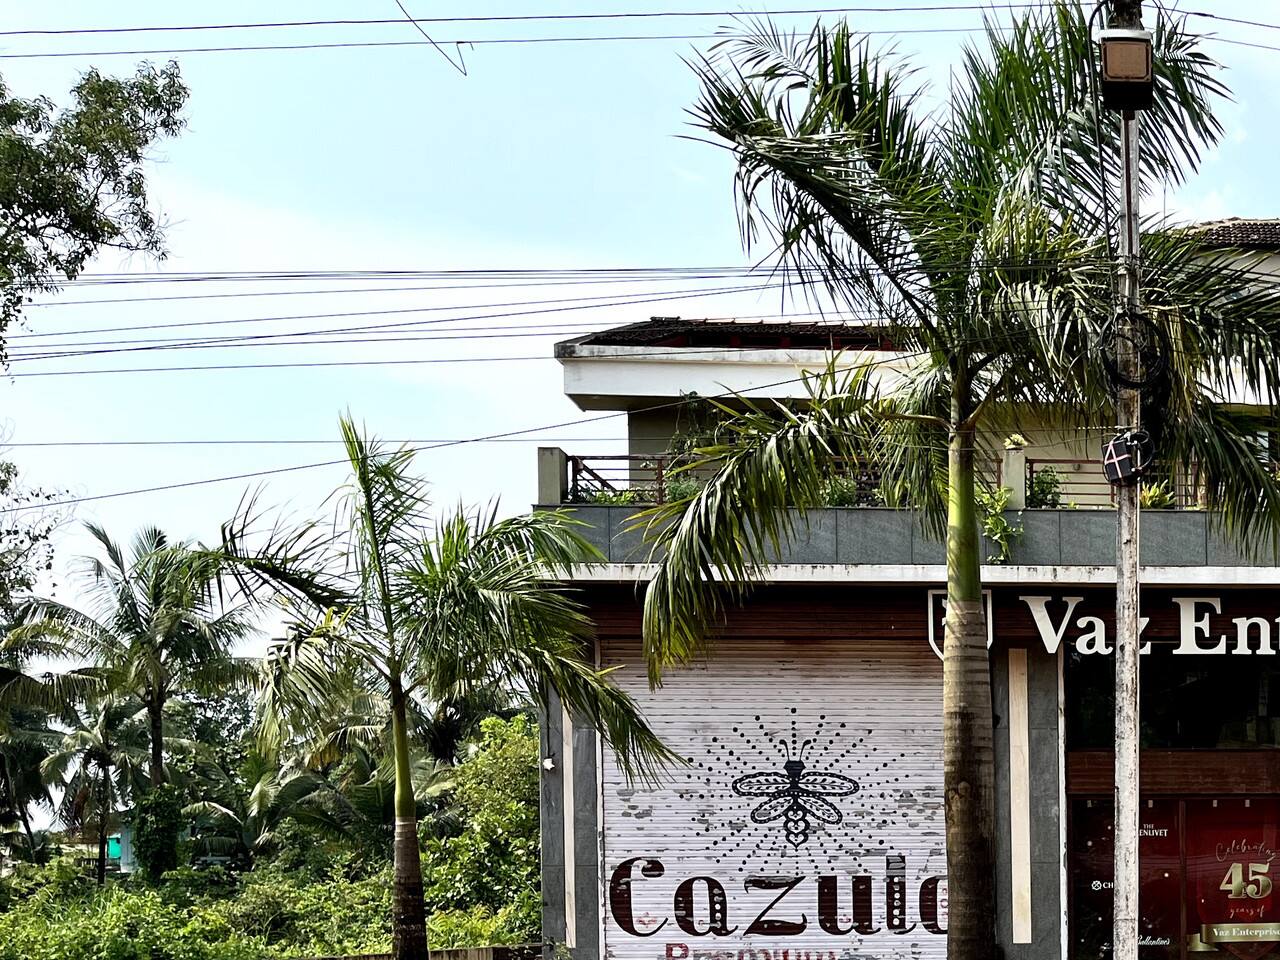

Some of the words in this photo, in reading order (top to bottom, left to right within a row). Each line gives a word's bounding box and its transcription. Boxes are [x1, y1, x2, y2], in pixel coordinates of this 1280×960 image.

[1139, 828, 1168, 837] ENLIVET
[1215, 838, 1276, 862] Celebrating
[1219, 862, 1273, 899] 45
[1229, 907, 1254, 919] years
[1256, 904, 1265, 918] of
[1213, 928, 1229, 936] Vaz
